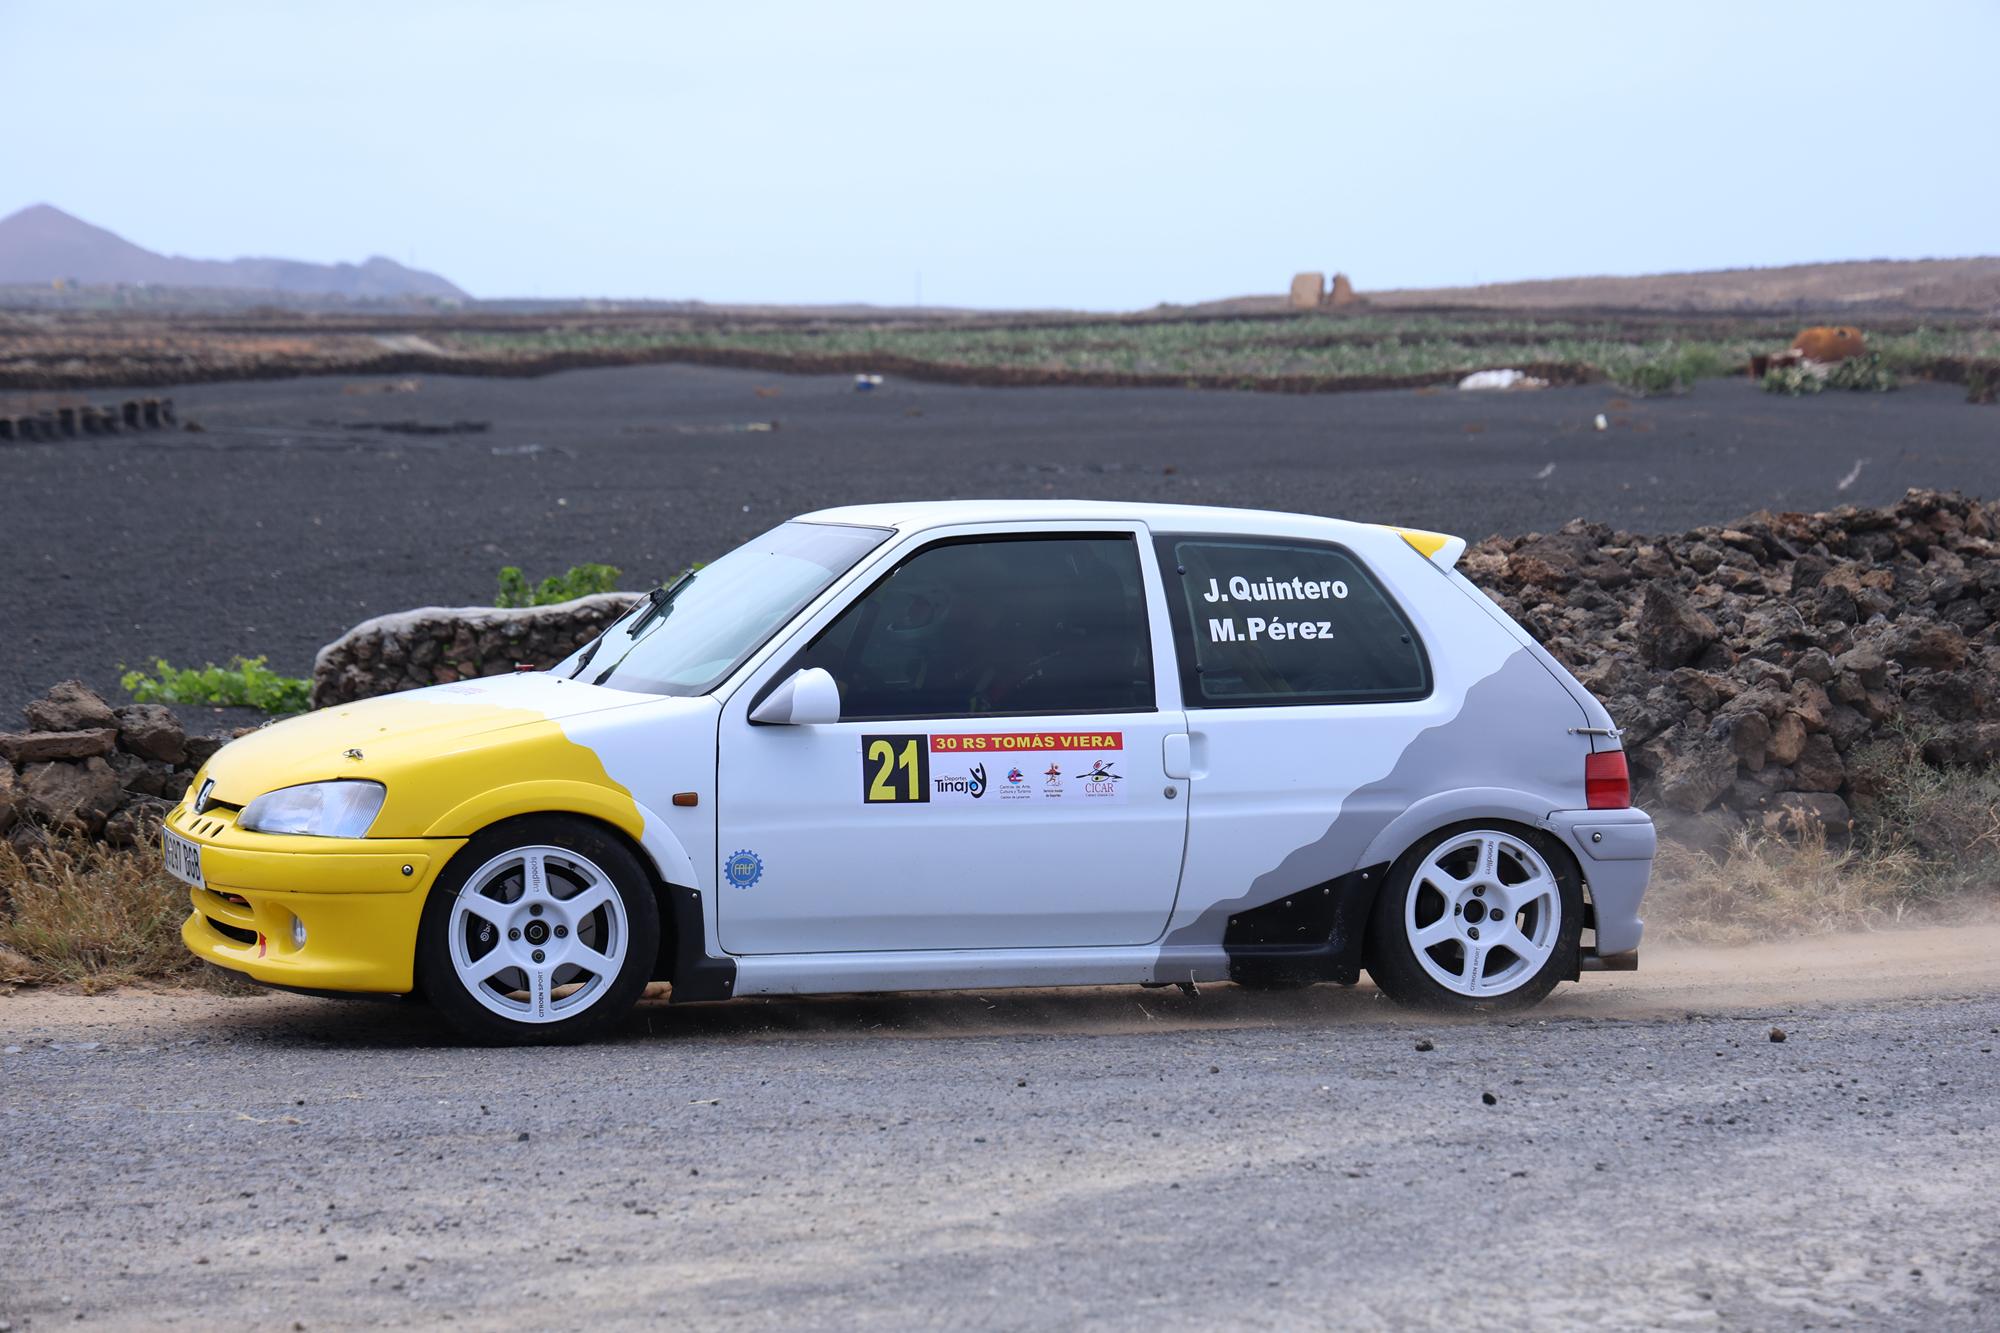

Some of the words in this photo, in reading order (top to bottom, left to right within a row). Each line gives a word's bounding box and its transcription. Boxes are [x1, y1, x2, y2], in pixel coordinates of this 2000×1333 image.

[1204, 576, 1348, 602] J.Quintero
[1209, 617, 1334, 642] M.Pérez
[935, 738, 957, 749] 30
[963, 737, 986, 748] RS
[992, 734, 1055, 748] TOMÁS
[1061, 735, 1116, 748] VIERA
[868, 739, 919, 801] 21
[1085, 783, 1114, 793] CICAR
